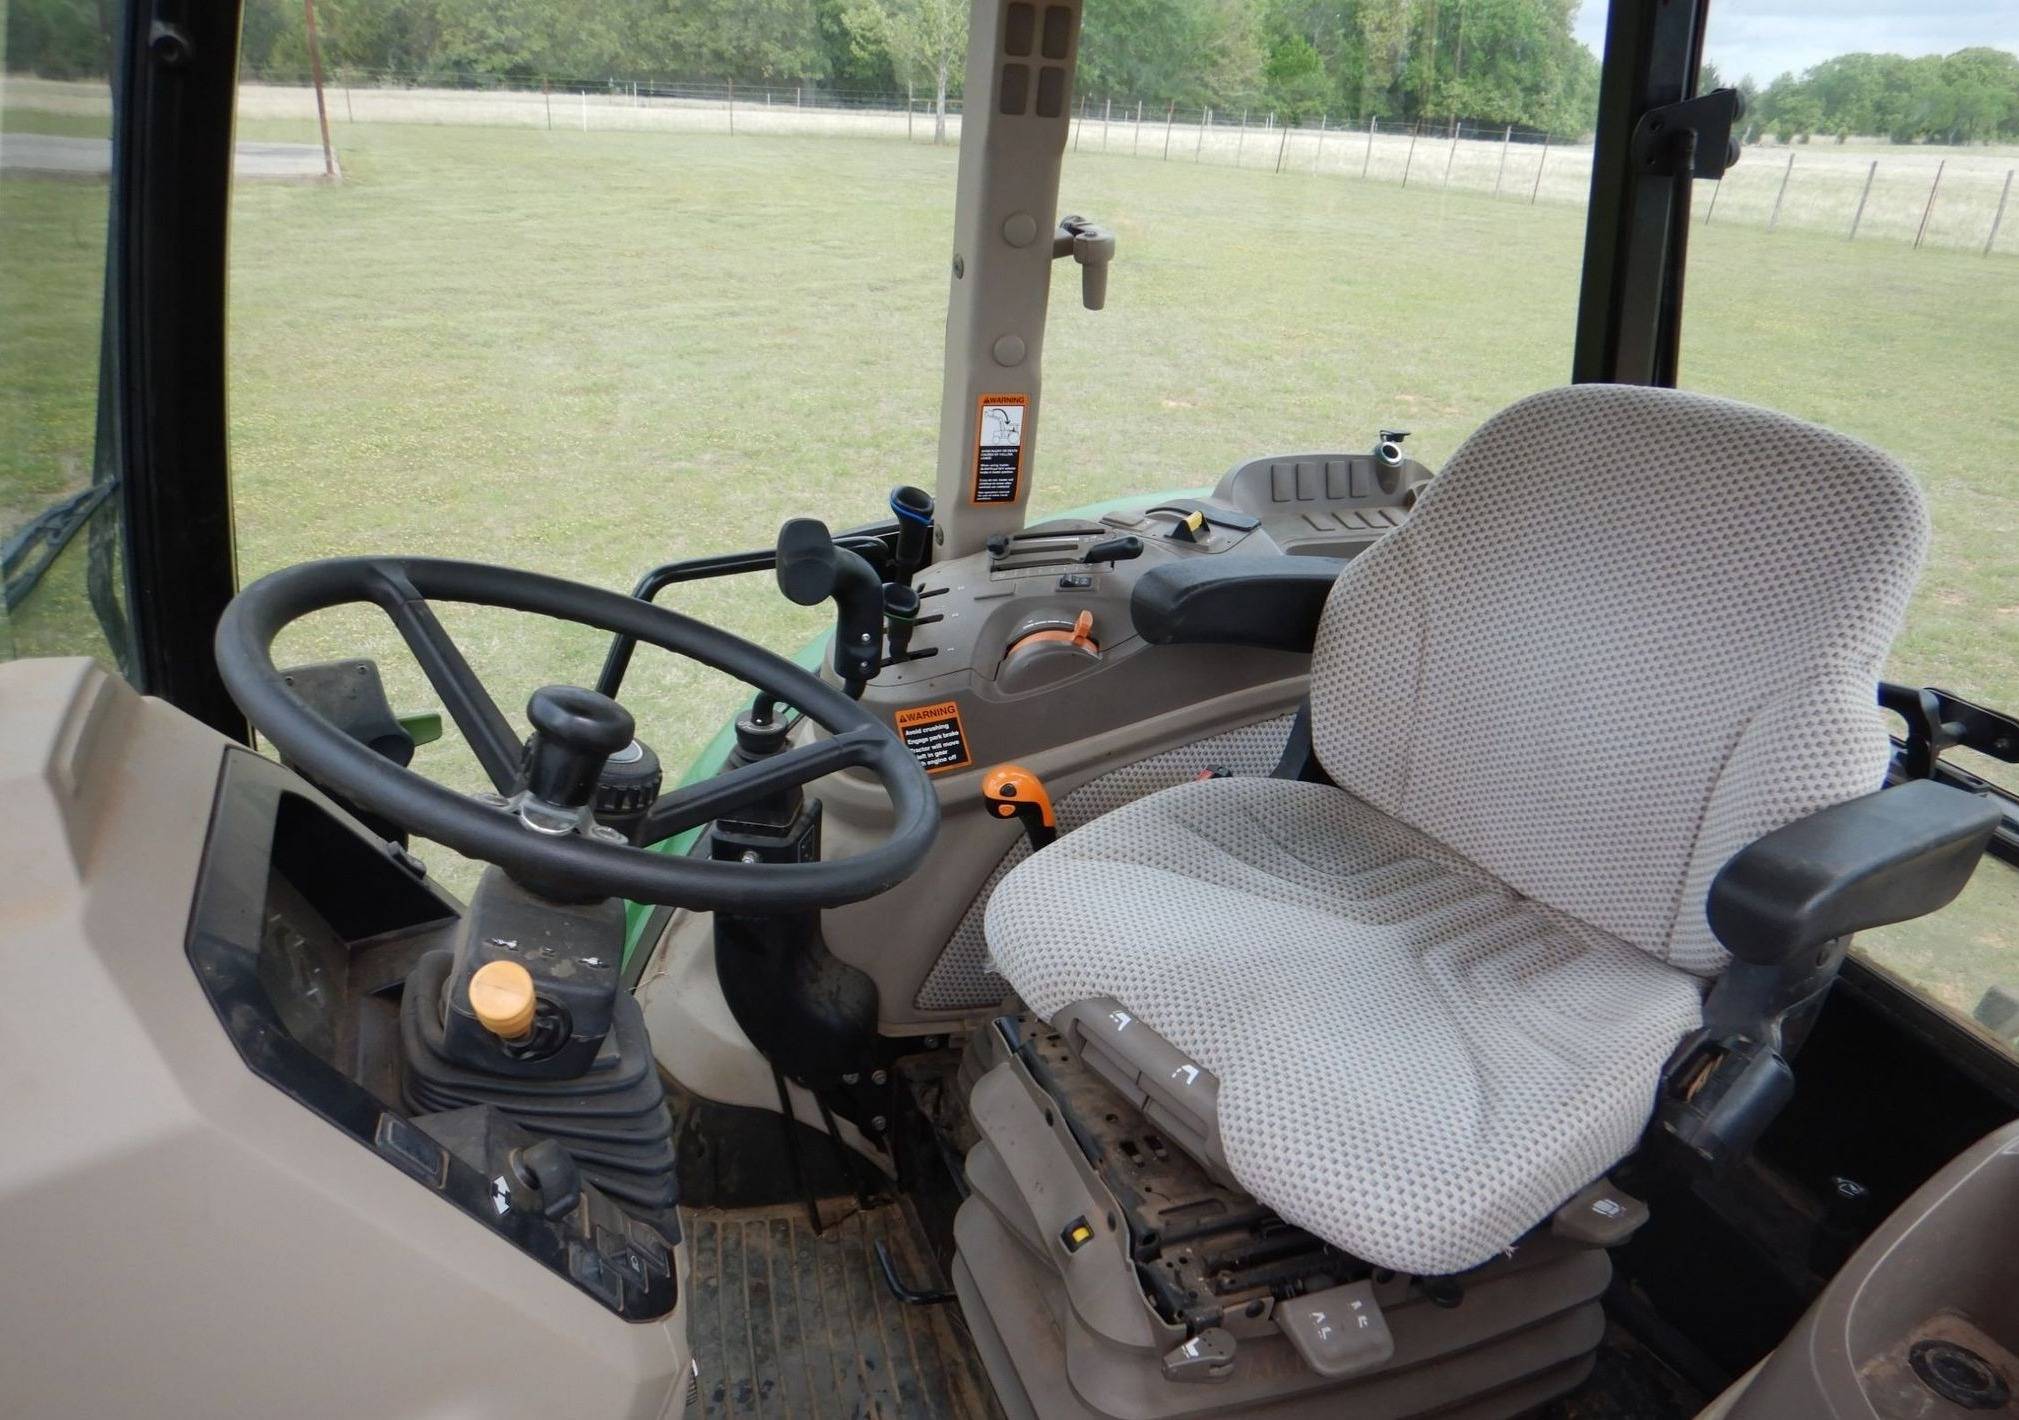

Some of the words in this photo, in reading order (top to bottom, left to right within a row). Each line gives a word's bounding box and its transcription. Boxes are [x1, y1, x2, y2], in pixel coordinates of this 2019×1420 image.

[907, 705, 955, 720] WARNING
[923, 724, 949, 732] crushing
[934, 749, 948, 757] gear
[927, 757, 947, 765] engine
